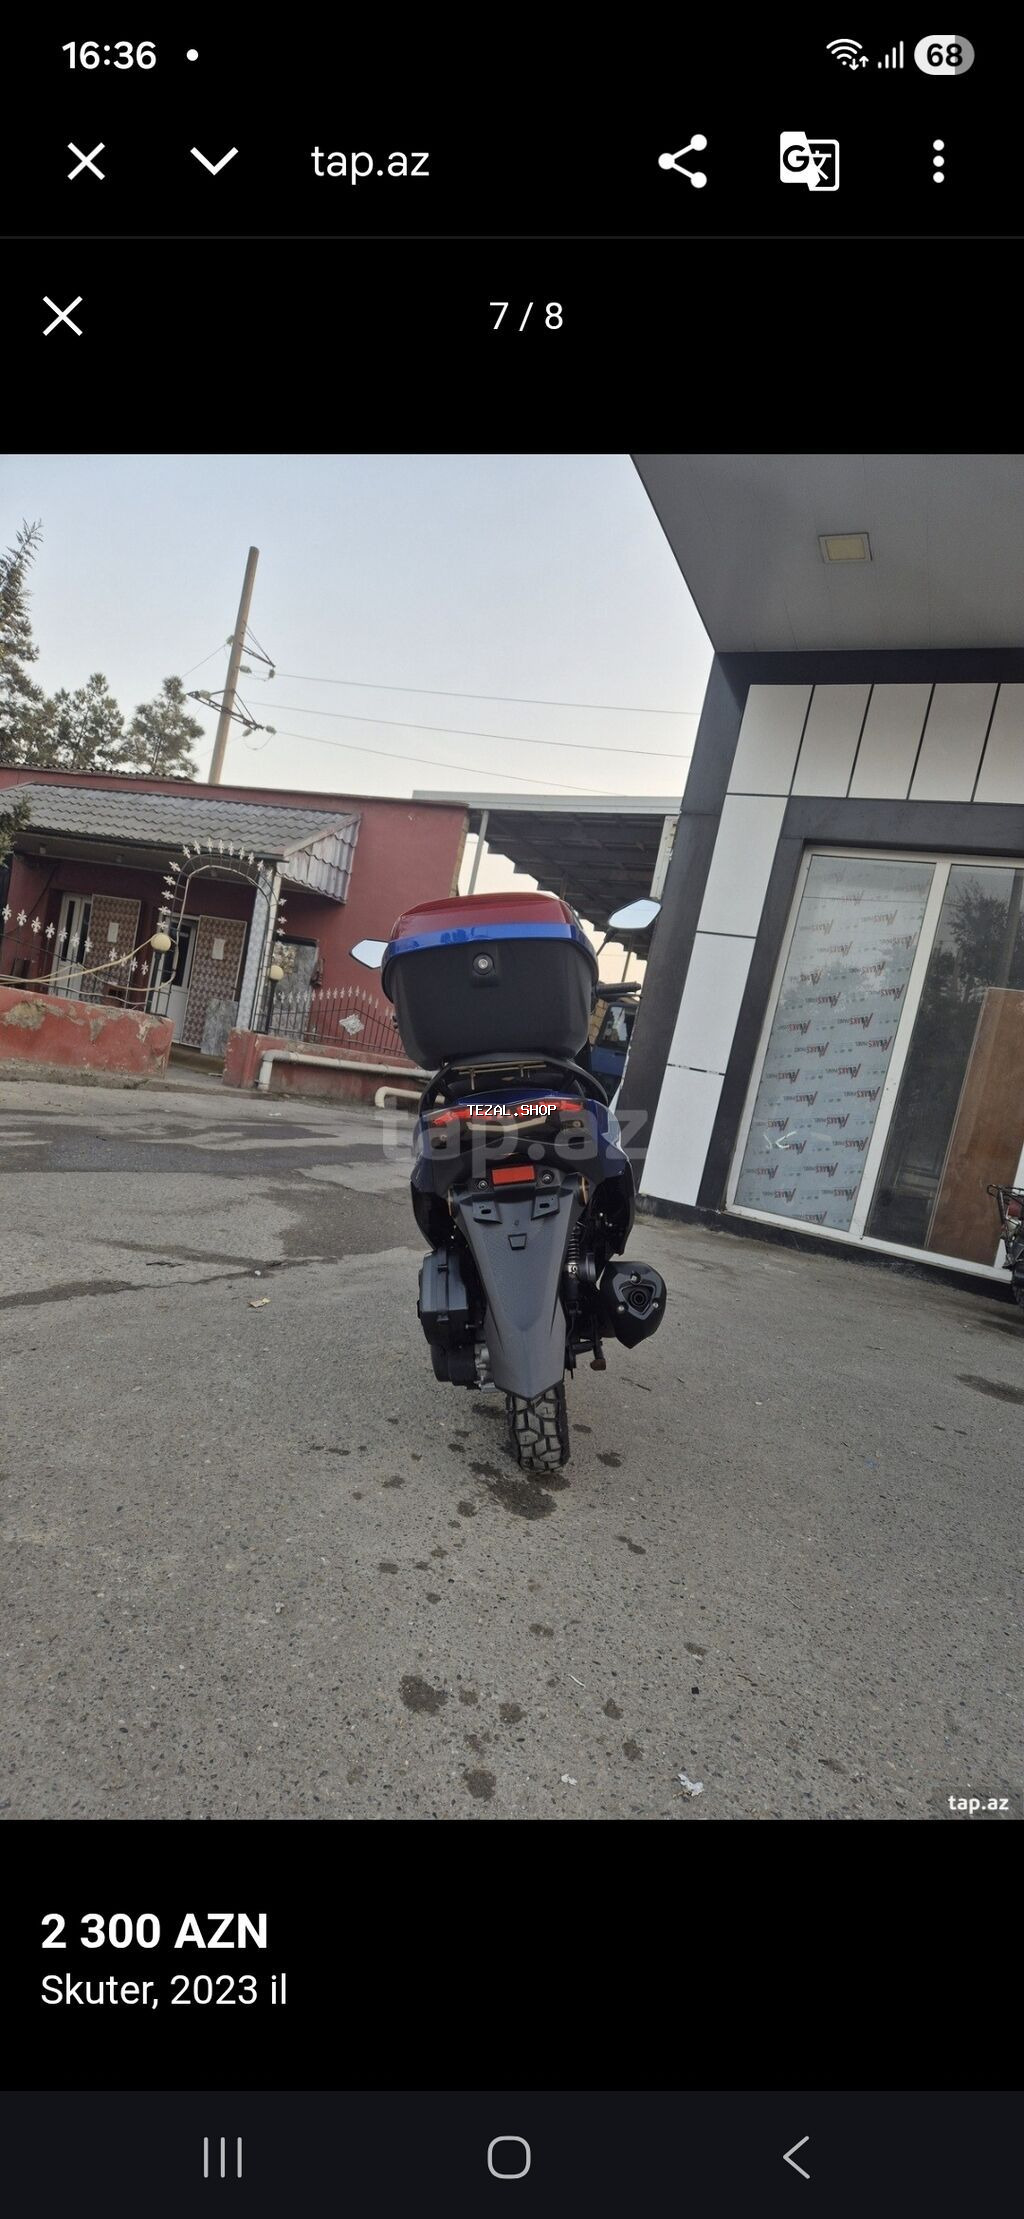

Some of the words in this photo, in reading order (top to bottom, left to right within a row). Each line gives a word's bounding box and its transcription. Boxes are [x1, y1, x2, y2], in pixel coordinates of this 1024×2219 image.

[62, 41, 157, 70] 16:36
[926, 43, 963, 67] 68
[311, 146, 430, 186] tap.az
[489, 301, 509, 330] 7
[518, 301, 534, 332] /
[544, 301, 564, 330] 8
[42, 1912, 67, 1949] 2
[80, 1912, 161, 1949] 300
[173, 1912, 268, 1949] AZN
[41, 1972, 159, 2010] Skuter,
[170, 1974, 258, 2005] 2023
[271, 1972, 287, 2005] il
